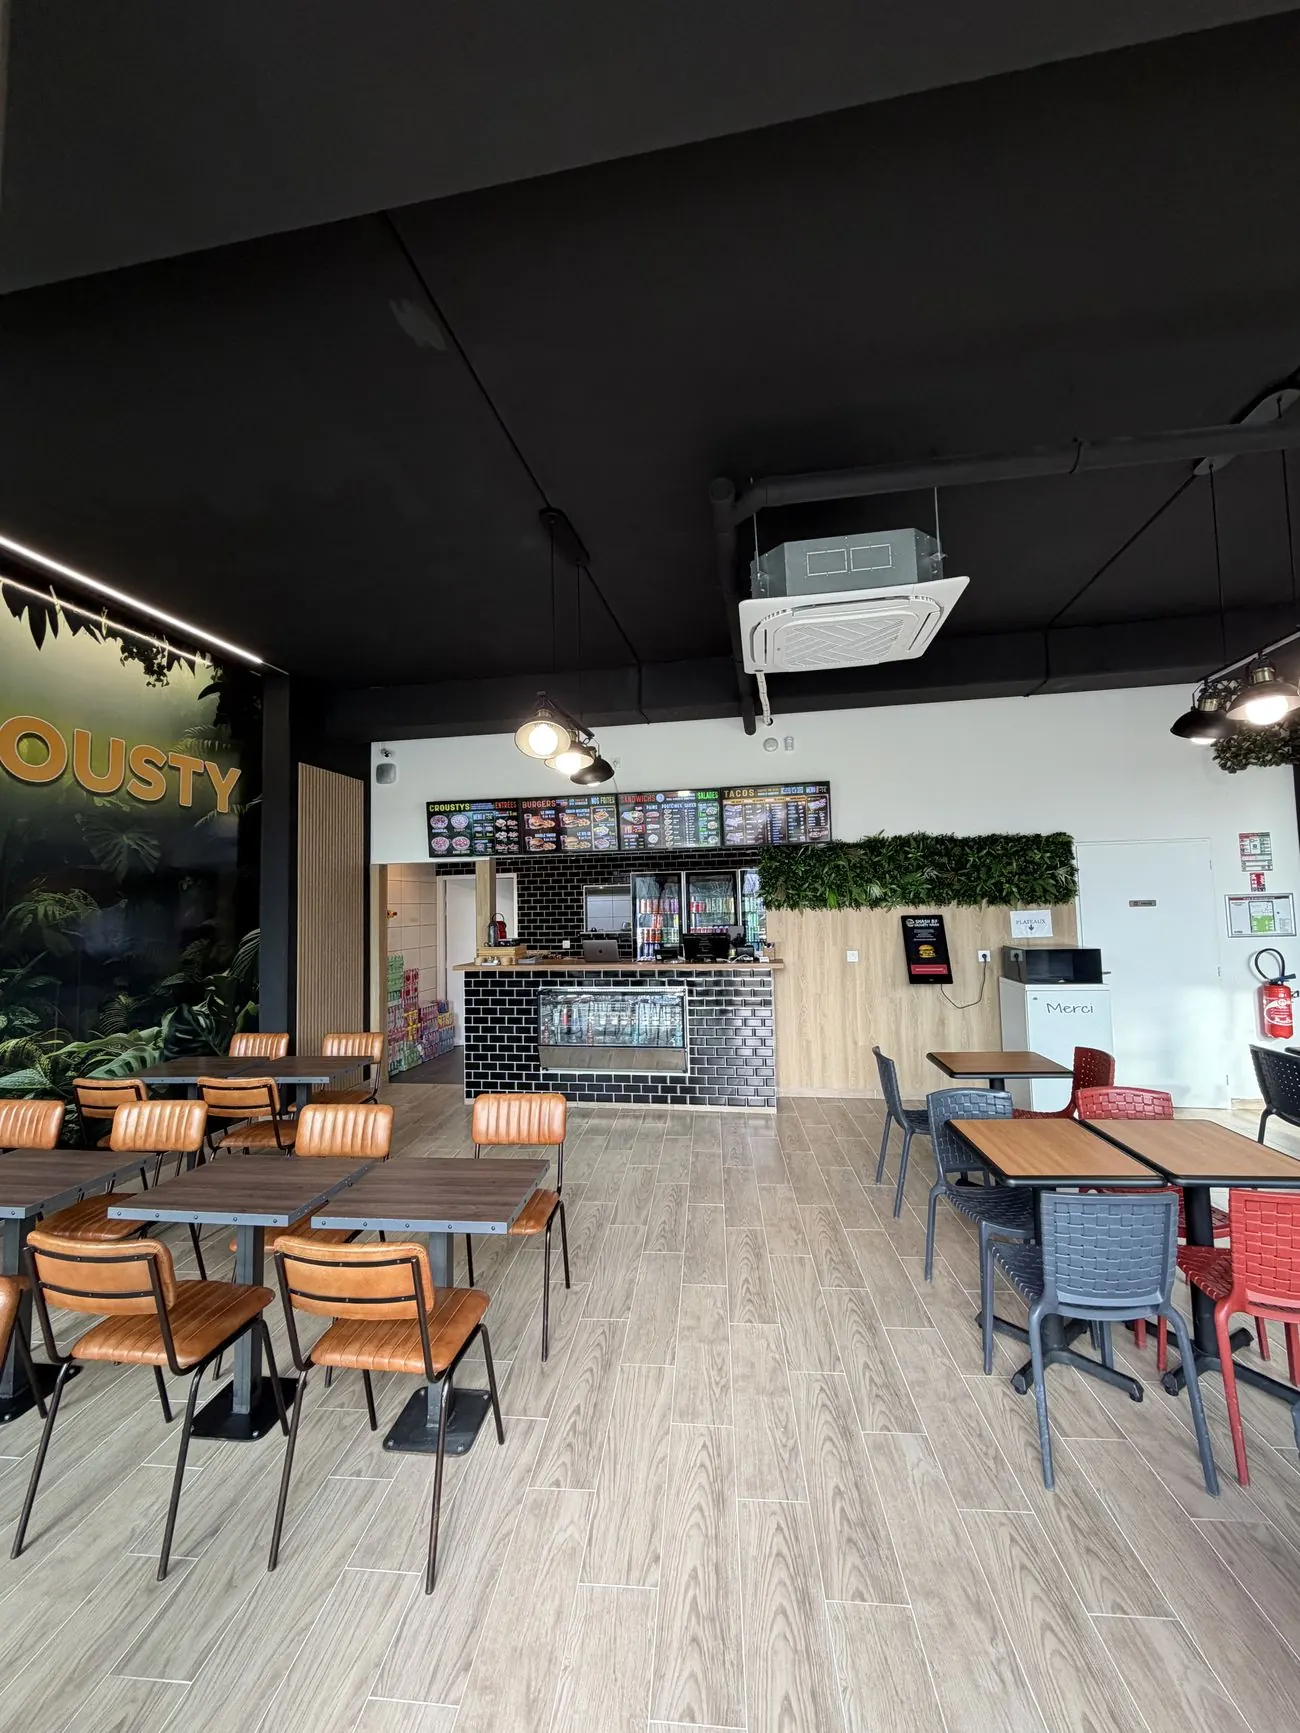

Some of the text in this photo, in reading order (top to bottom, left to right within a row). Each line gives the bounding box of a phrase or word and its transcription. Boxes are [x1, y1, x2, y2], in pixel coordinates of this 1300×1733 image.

[697, 791, 719, 800] SALADES
[723, 789, 755, 798] TACOS
[429, 803, 470, 812] CROUSTYS
[495, 801, 517, 809] ENTRÉES
[522, 799, 557, 809] BURGERS
[1046, 1002, 1094, 1014] Merci
